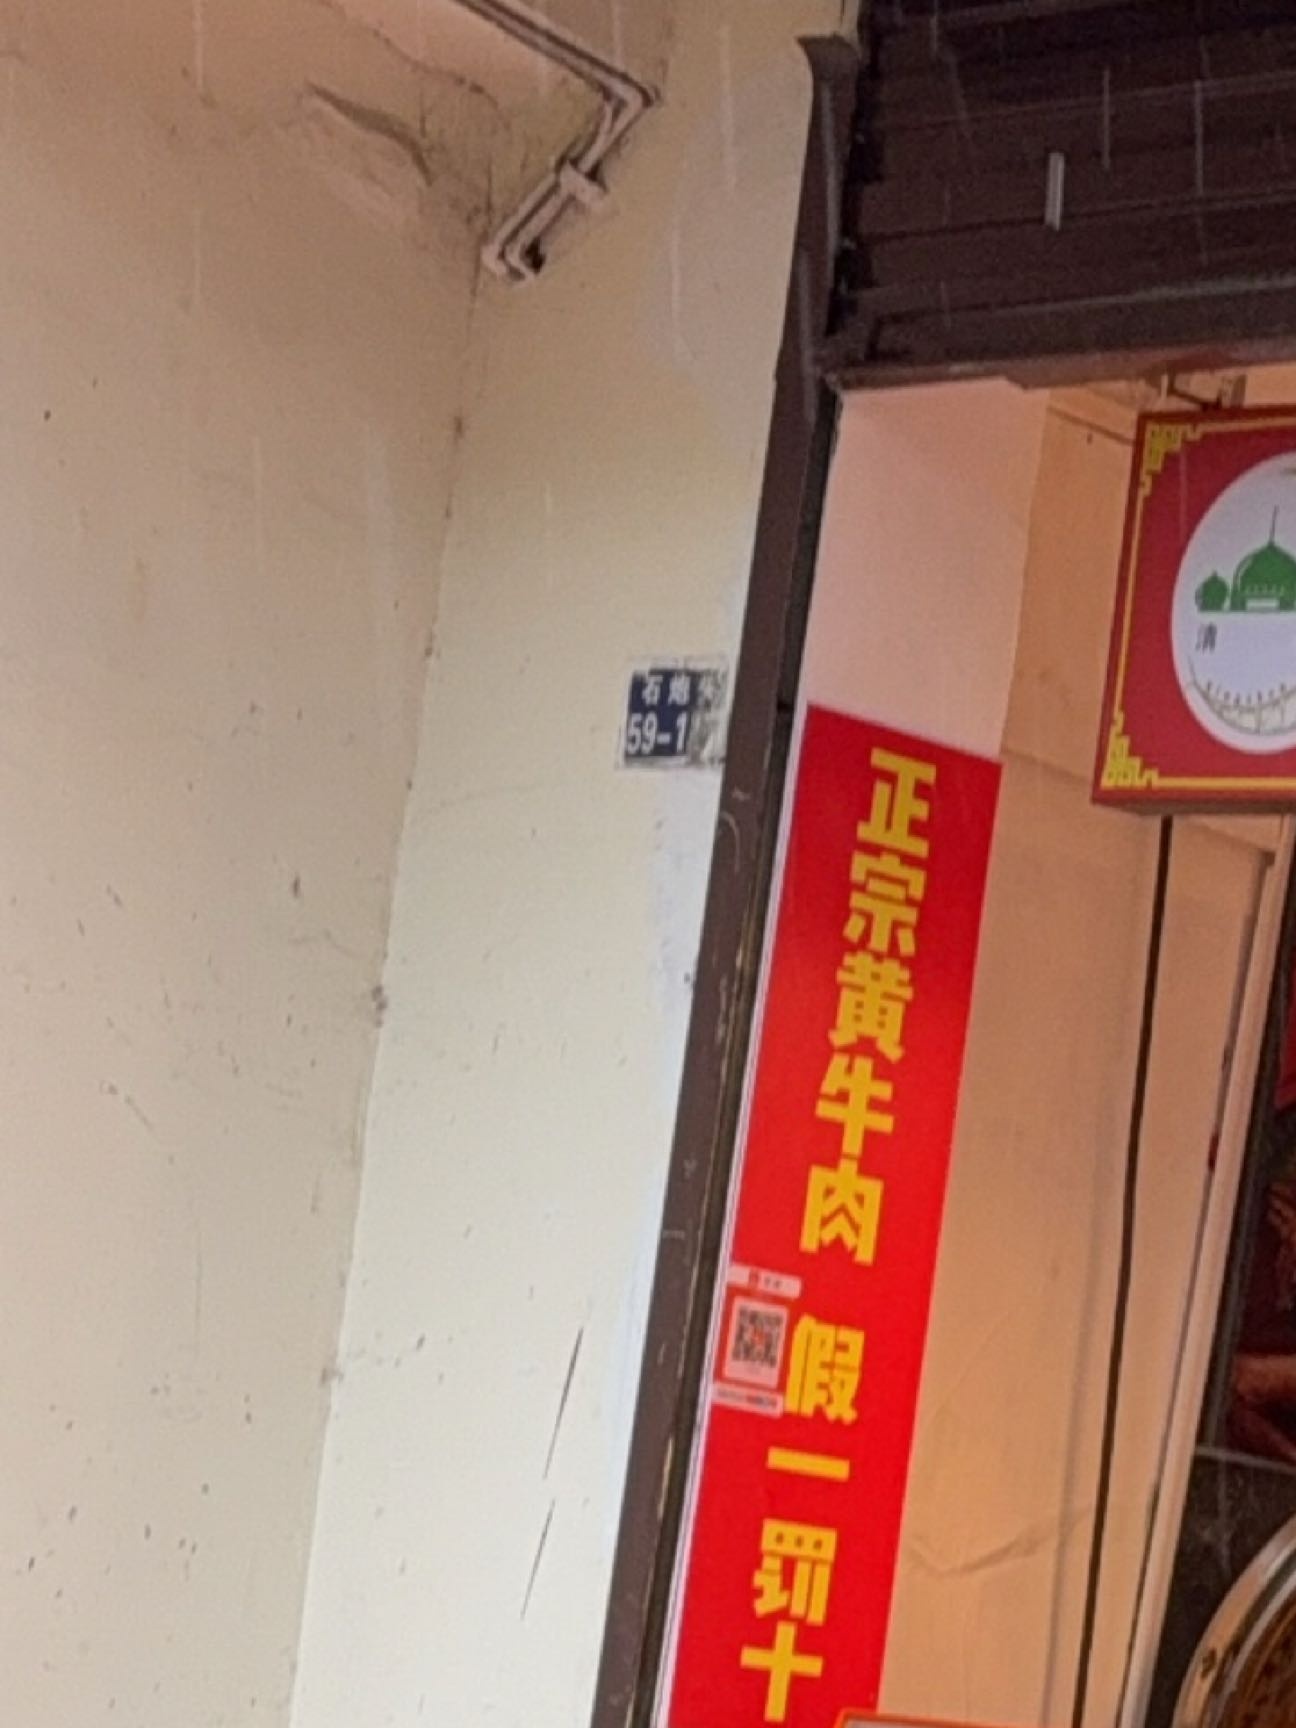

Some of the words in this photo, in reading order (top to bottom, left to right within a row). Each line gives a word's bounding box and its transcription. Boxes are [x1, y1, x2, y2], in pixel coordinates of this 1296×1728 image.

[626, 711, 687, 755] 59-1
[799, 746, 937, 1265] 正宗黄牛肉
[739, 1314, 866, 1723] 假一罚十
